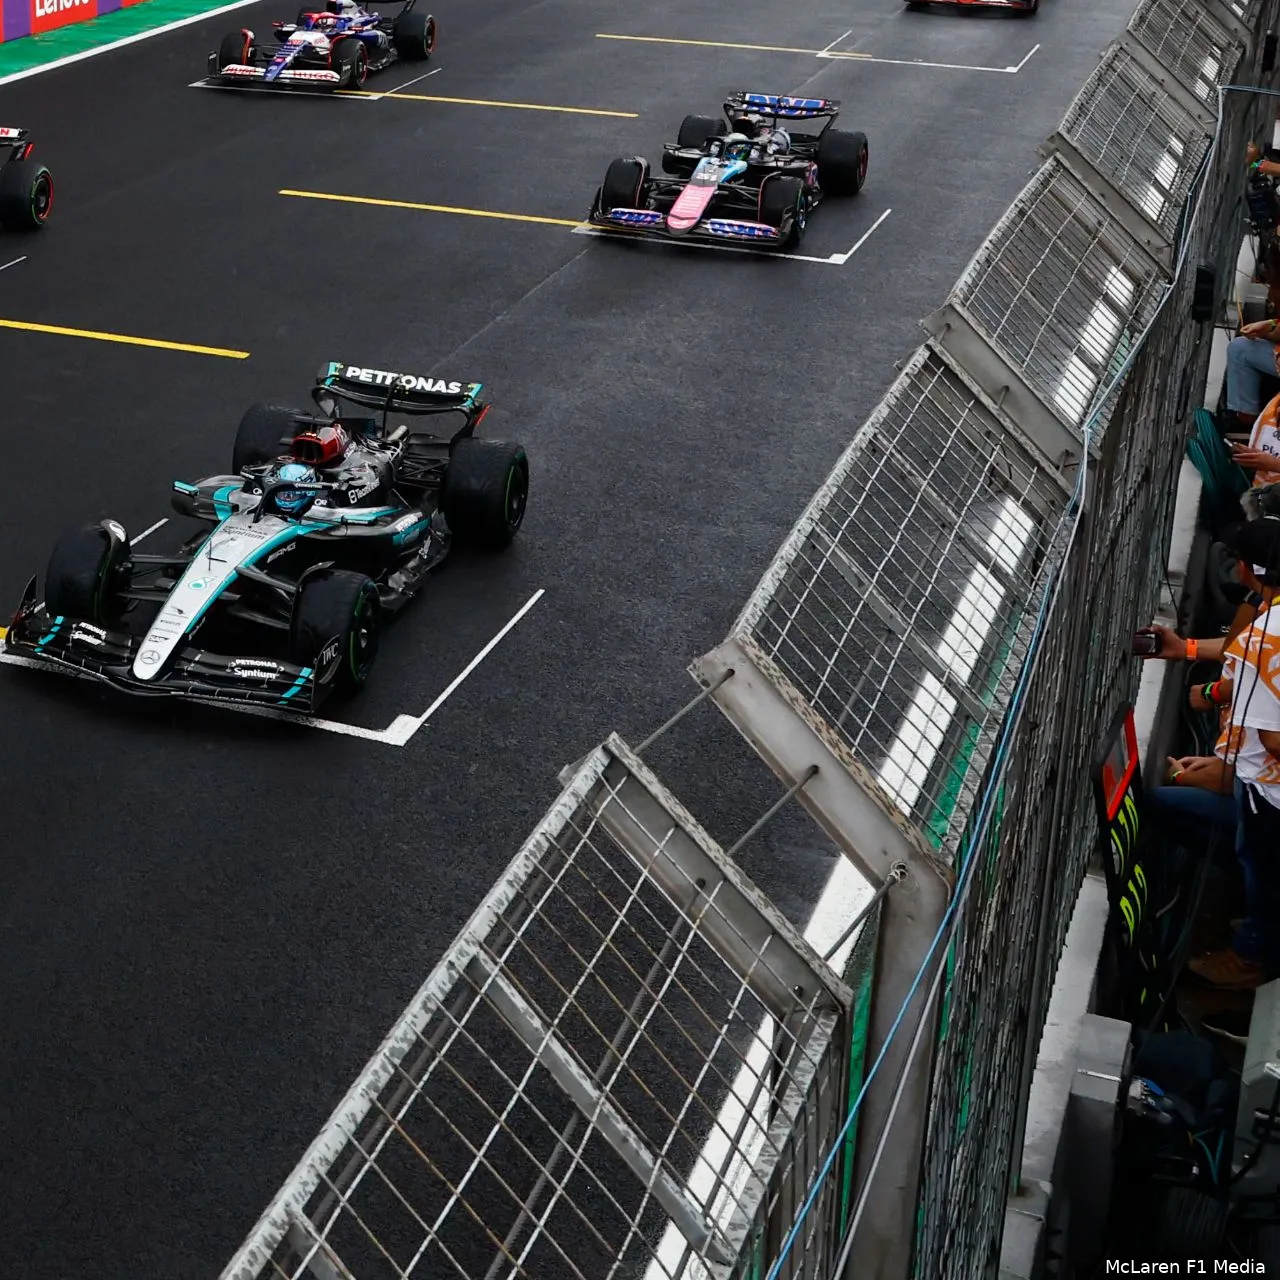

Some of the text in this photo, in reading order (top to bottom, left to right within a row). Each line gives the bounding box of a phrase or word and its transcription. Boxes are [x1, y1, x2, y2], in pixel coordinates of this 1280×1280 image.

[345, 366, 462, 393] PETRONAS
[235, 659, 278, 669] PETRONAS
[233, 668, 278, 680] Syntium
